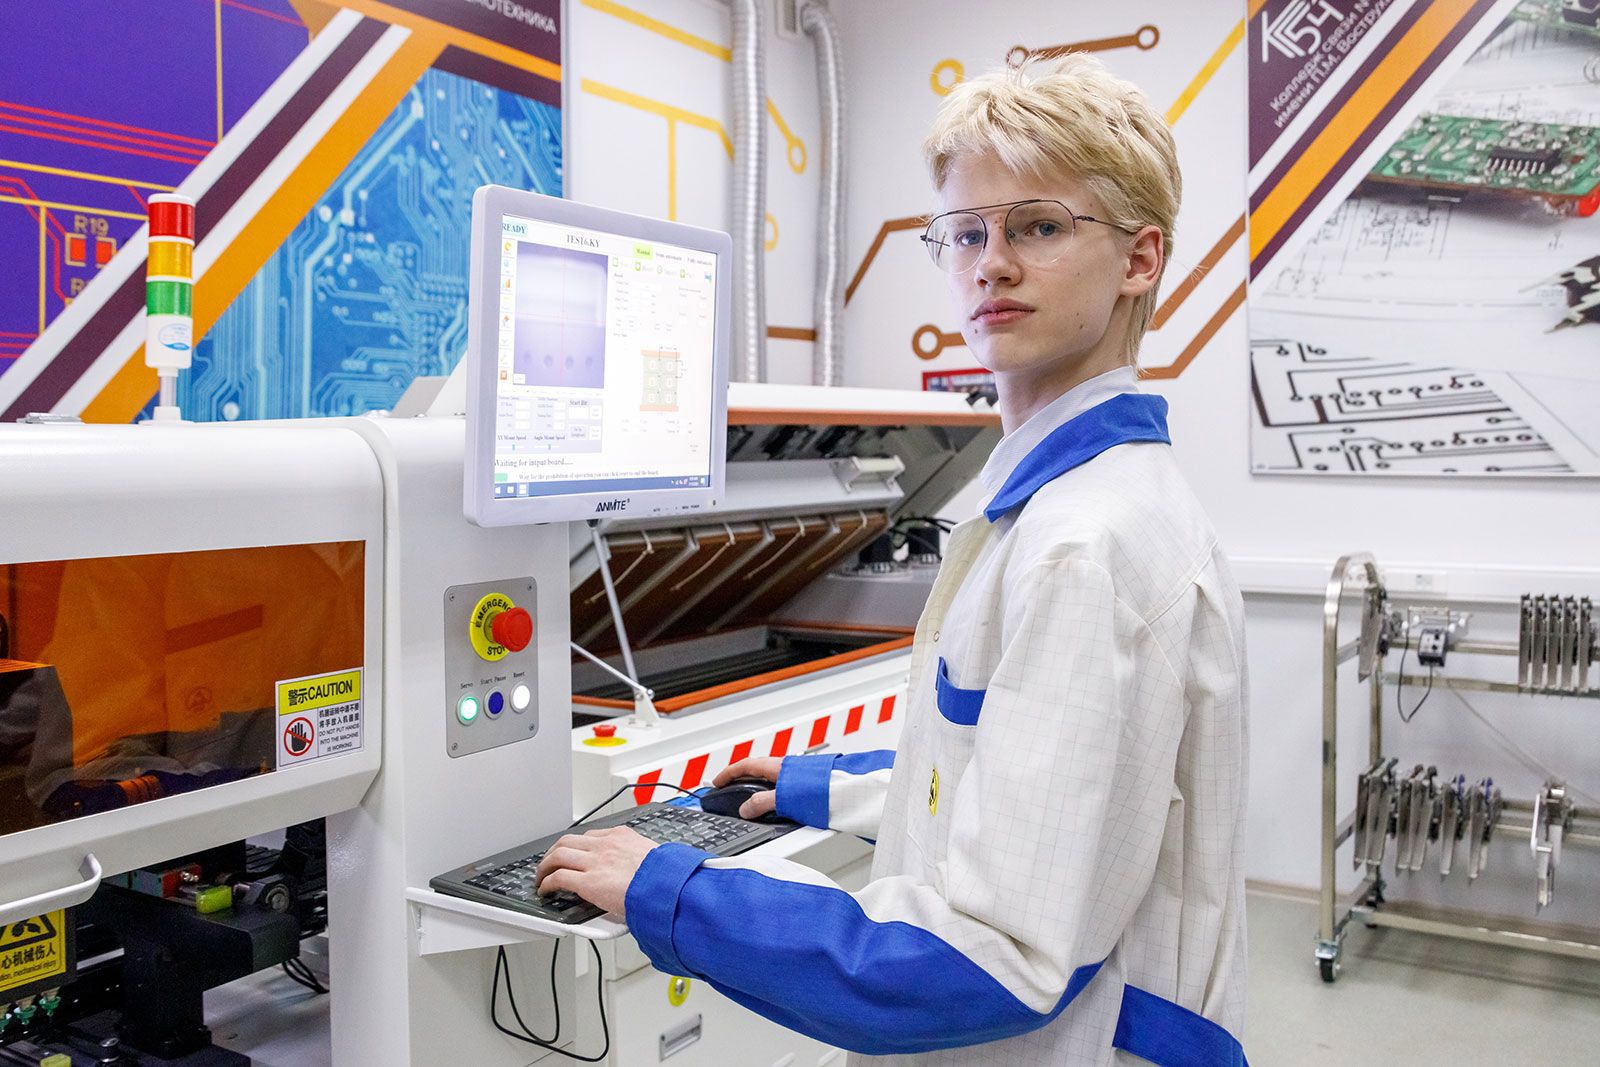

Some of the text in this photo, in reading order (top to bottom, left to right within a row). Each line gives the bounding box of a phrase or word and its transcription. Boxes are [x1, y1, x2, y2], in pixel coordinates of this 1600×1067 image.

[1269, 51, 1325, 112] Колледж
[1322, 12, 1357, 53] связи
[1274, 82, 1314, 128] имени
[74, 214, 108, 237] R19
[502, 223, 526, 234] READY
[518, 459, 528, 467] for
[475, 598, 511, 628] EMERGEN
[487, 645, 505, 656] STO
[340, 732, 359, 740] MACHINE
[332, 742, 352, 751] WORKING
